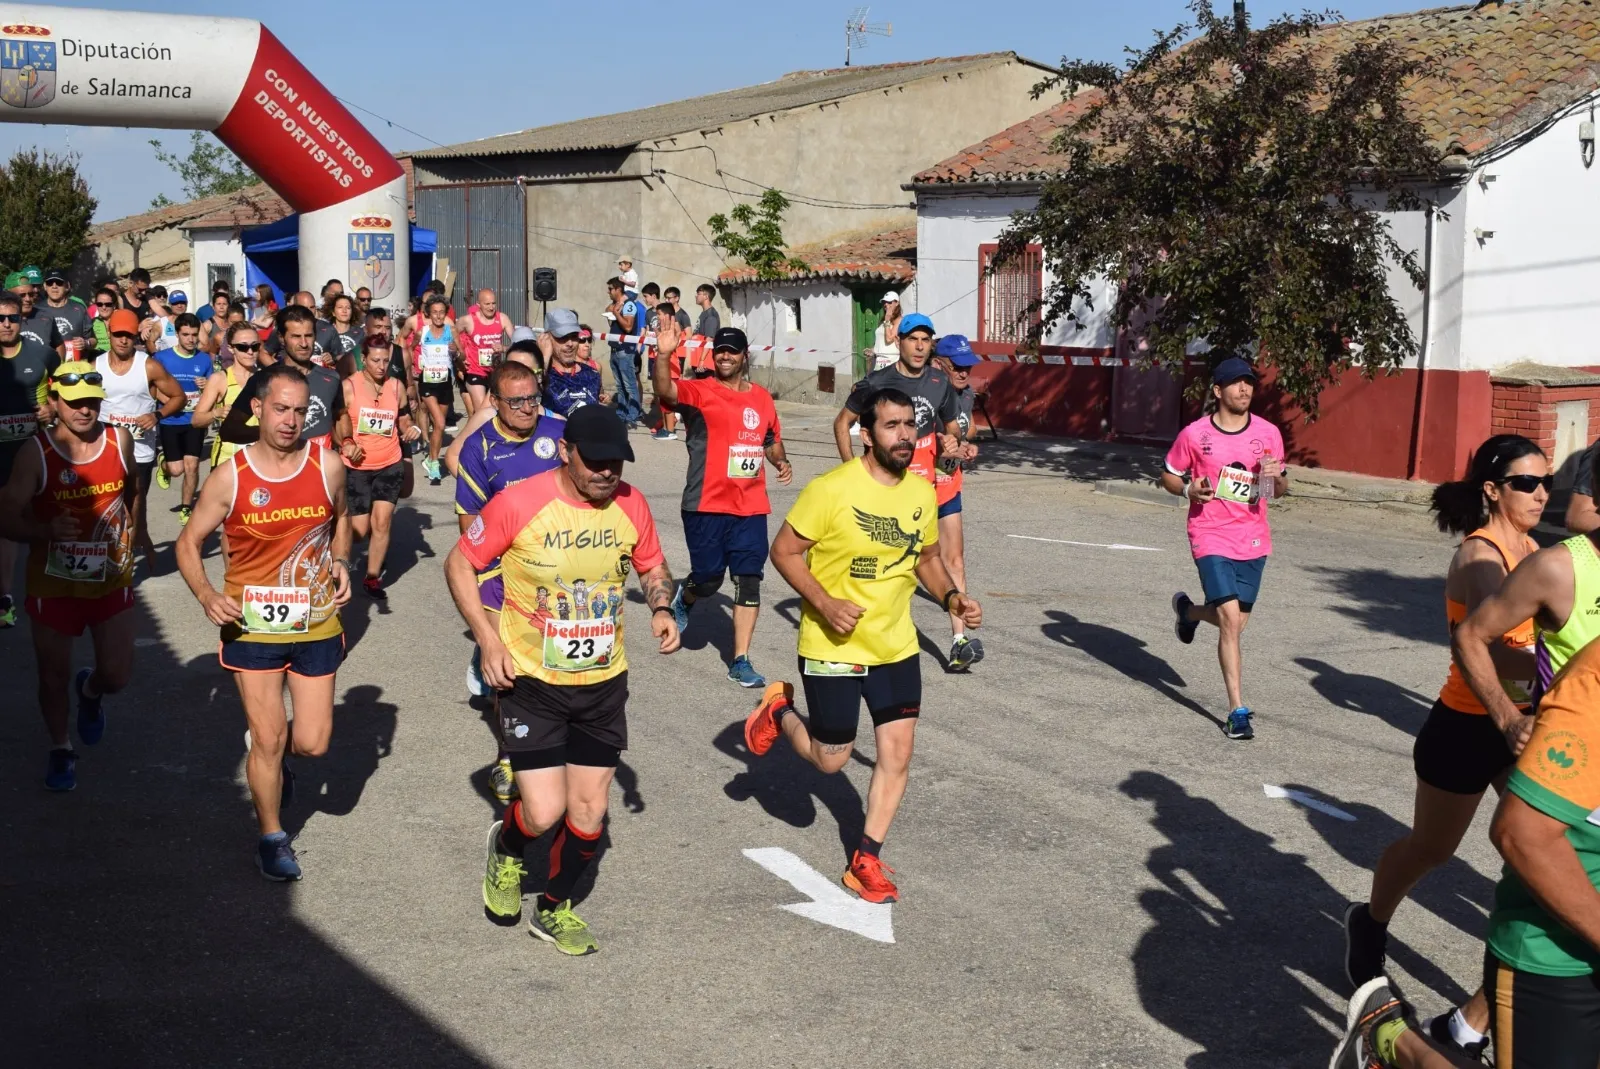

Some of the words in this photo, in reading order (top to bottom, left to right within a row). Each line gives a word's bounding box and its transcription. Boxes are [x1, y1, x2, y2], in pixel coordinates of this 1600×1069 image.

[62, 39, 172, 61] Diputación
[61, 81, 79, 95] de
[87, 78, 192, 98] Salamanca
[265, 69, 298, 103] CON
[297, 101, 374, 178] NUESTROS
[254, 90, 353, 188] DEPORTISTAS
[627, 305, 633, 313] 3
[109, 414, 137, 423] bedun
[361, 409, 394, 420] bedunia
[9, 424, 26, 434] 12
[370, 419, 383, 429] 91
[738, 431, 761, 442] UPSA
[741, 458, 756, 470] 66
[944, 458, 956, 470] 96
[54, 480, 124, 500] VILLORUELA
[1232, 481, 1250, 497] 72
[242, 505, 326, 525] VILLORUELA
[874, 520, 897, 533] FLY
[544, 529, 623, 549] MIGUEL
[870, 530, 900, 542] MAD
[64, 555, 88, 572] 34
[244, 588, 309, 604] bedunia
[262, 604, 290, 623] 39
[546, 622, 614, 638] bedunia
[566, 638, 594, 660] 23
